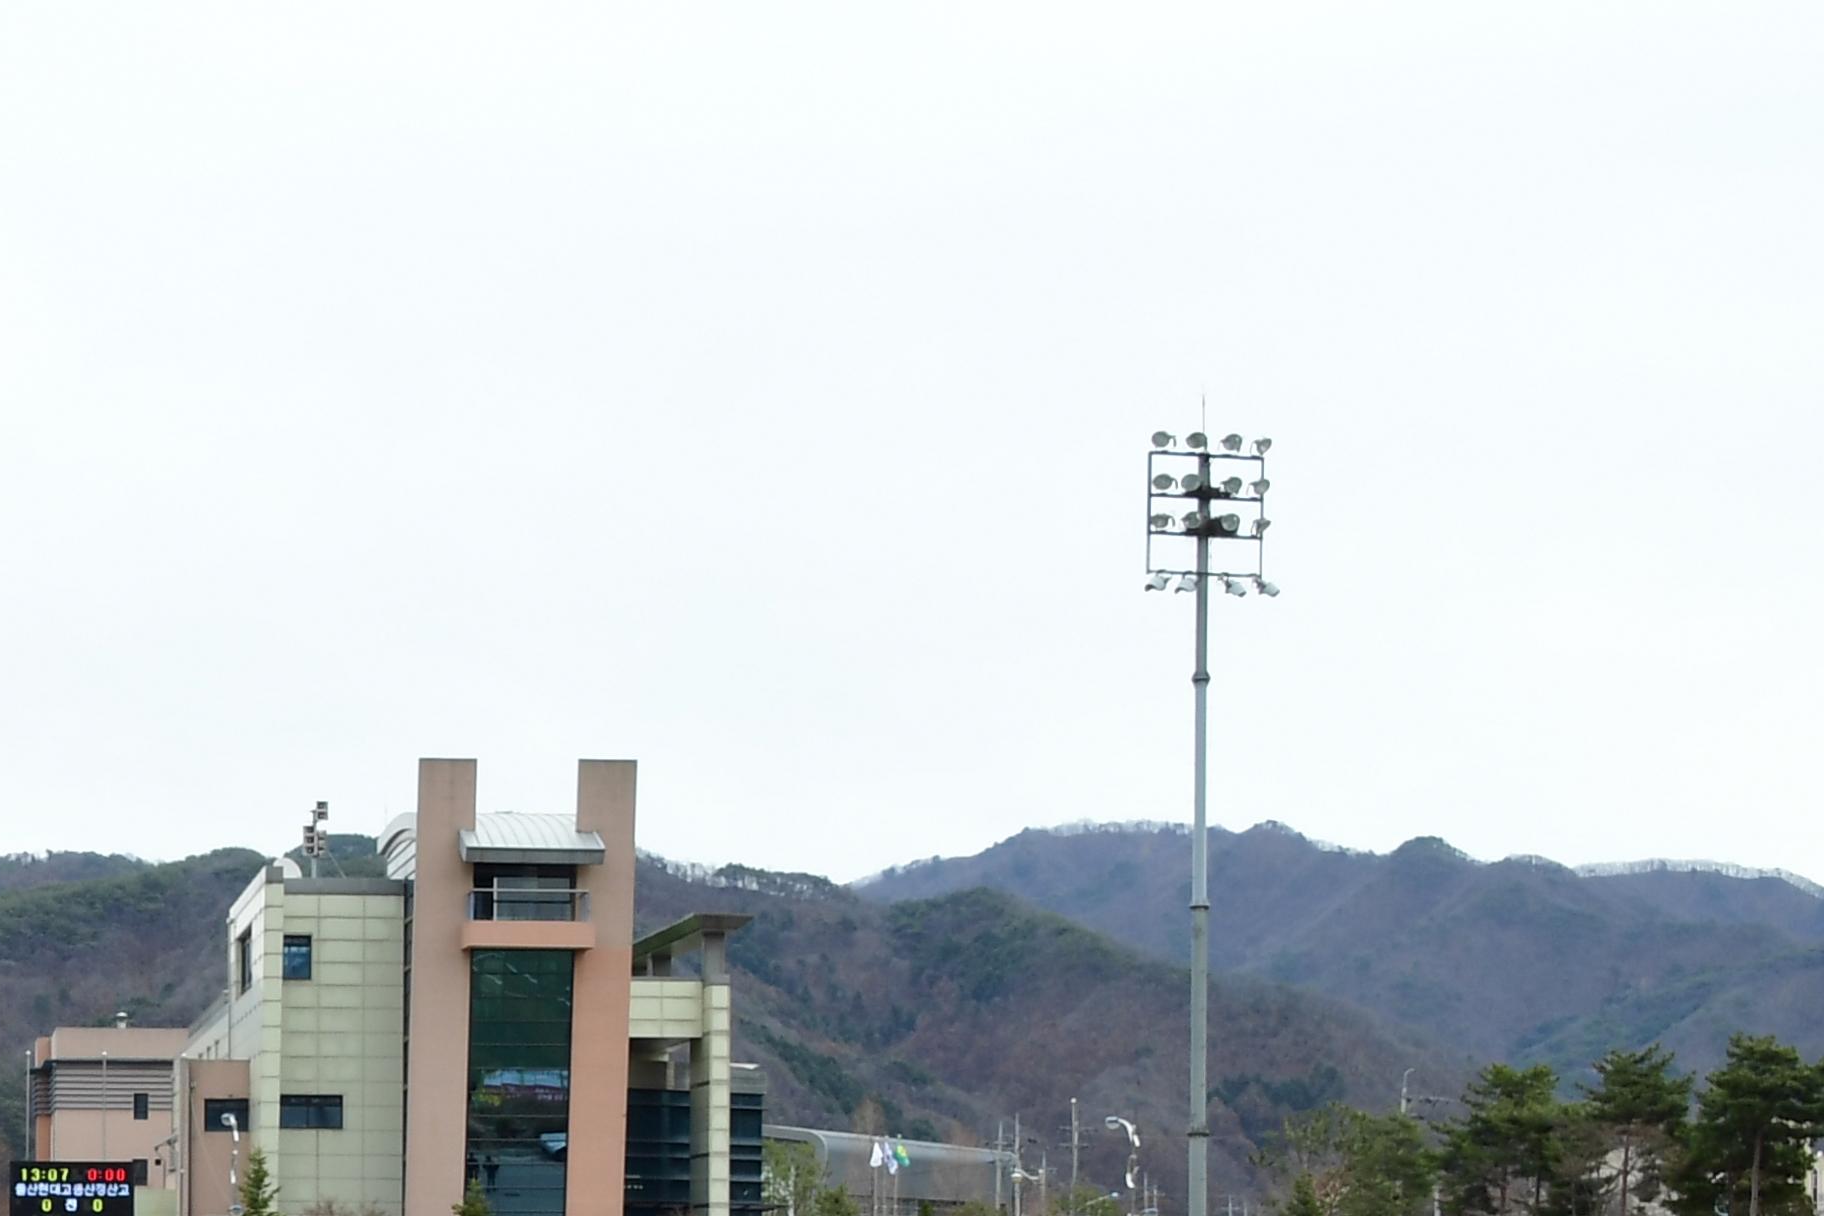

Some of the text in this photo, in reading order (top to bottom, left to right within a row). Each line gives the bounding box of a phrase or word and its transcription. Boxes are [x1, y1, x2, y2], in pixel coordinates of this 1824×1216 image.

[20, 1168, 127, 1182] 13:07 0:00
[41, 1198, 52, 1213] 0
[92, 1198, 103, 1213] 0
